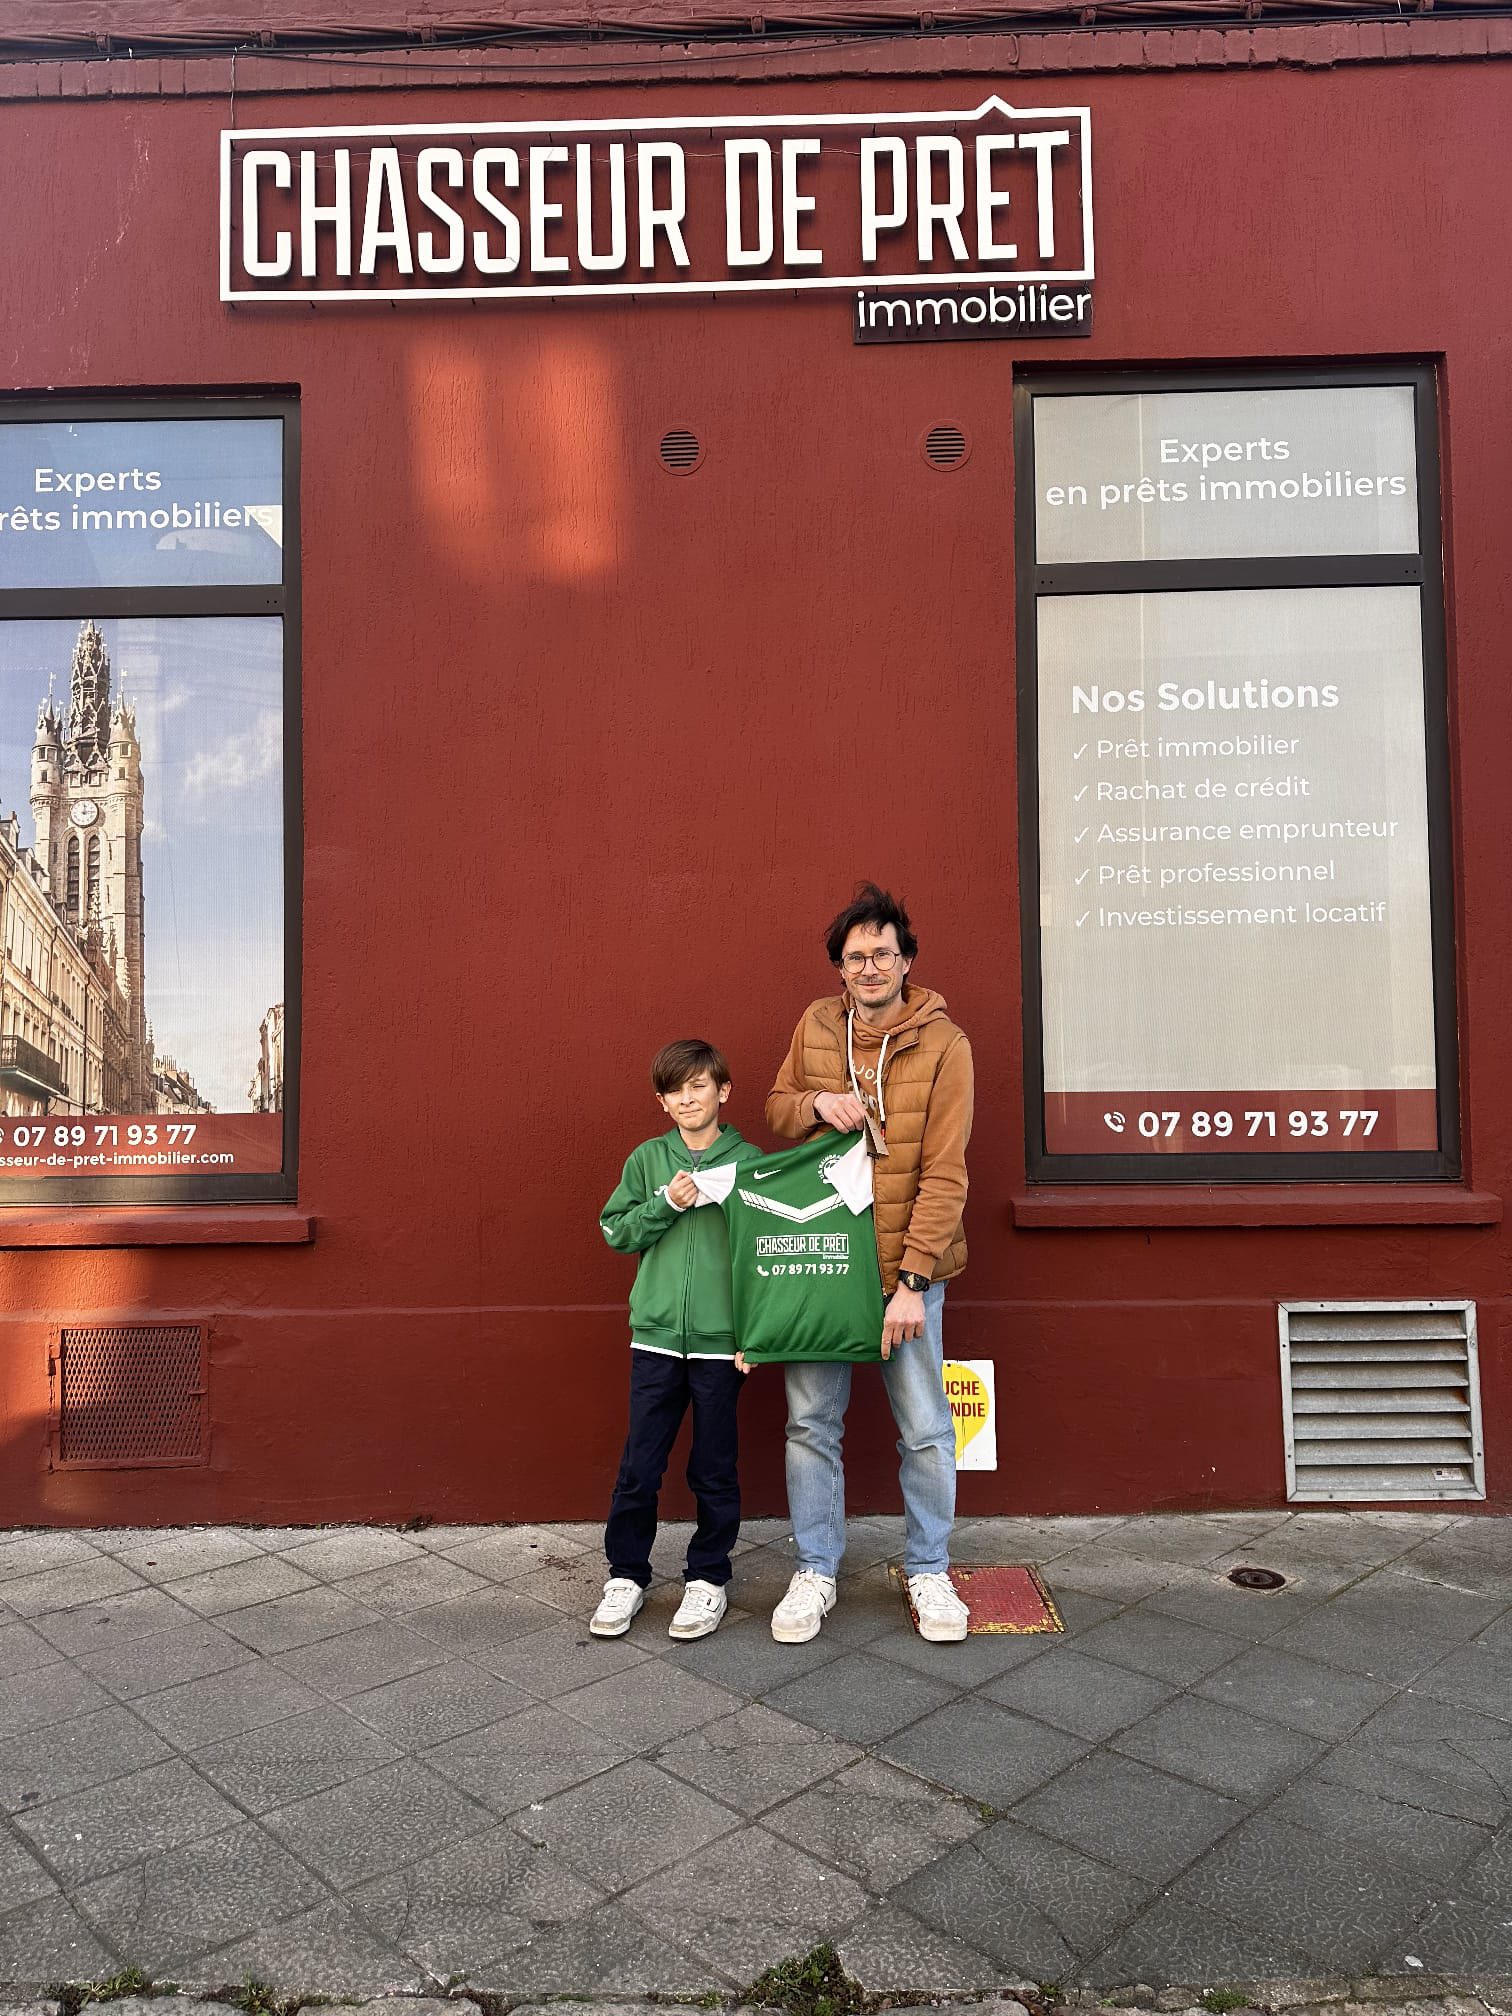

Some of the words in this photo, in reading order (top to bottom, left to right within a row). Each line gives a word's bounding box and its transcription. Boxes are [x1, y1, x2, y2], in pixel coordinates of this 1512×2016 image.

[242, 141, 691, 278] CHASSEUR
[724, 137, 824, 267] DE
[856, 283, 1093, 330] immobilier
[1159, 437, 1290, 468] Experts
[34, 468, 162, 497] Experts
[1045, 486, 1088, 506] en
[1100, 478, 1189, 509] prêts
[1199, 470, 1407, 501] immobiliers
[72, 501, 273, 530] immobiliers
[1072, 685, 1146, 714] Nos
[1157, 679, 1340, 711] Solutions
[1097, 739, 1150, 759] Prêt
[1158, 735, 1300, 758] immobilier
[1097, 780, 1187, 801] Rachat
[1194, 778, 1228, 799] de
[1234, 776, 1311, 798] crédit
[1097, 823, 1232, 843] Assurance
[1239, 819, 1399, 843] emprunteur
[1099, 864, 1152, 885] Prêt
[1160, 860, 1336, 888] professionnel
[1099, 905, 1298, 928] Investissement
[1305, 902, 1387, 924] locatif
[13, 1125, 47, 1147] 07
[53, 1125, 86, 1147] 89
[94, 1125, 118, 1146] 71
[127, 1124, 158, 1145] 93
[166, 1124, 197, 1145] 77
[1138, 1111, 1181, 1137] 07
[1191, 1111, 1233, 1137] 89
[1244, 1111, 1277, 1137] 71
[1288, 1110, 1329, 1136] 93
[1339, 1110, 1379, 1136] 77
[758, 1236, 807, 1254] CHASSEUR
[808, 1235, 821, 1251] DE
[771, 1264, 786, 1276] 07
[788, 1264, 803, 1275] 89
[804, 1264, 817, 1275] 71
[819, 1264, 834, 1275] 93
[836, 1263, 850, 1275] 77
